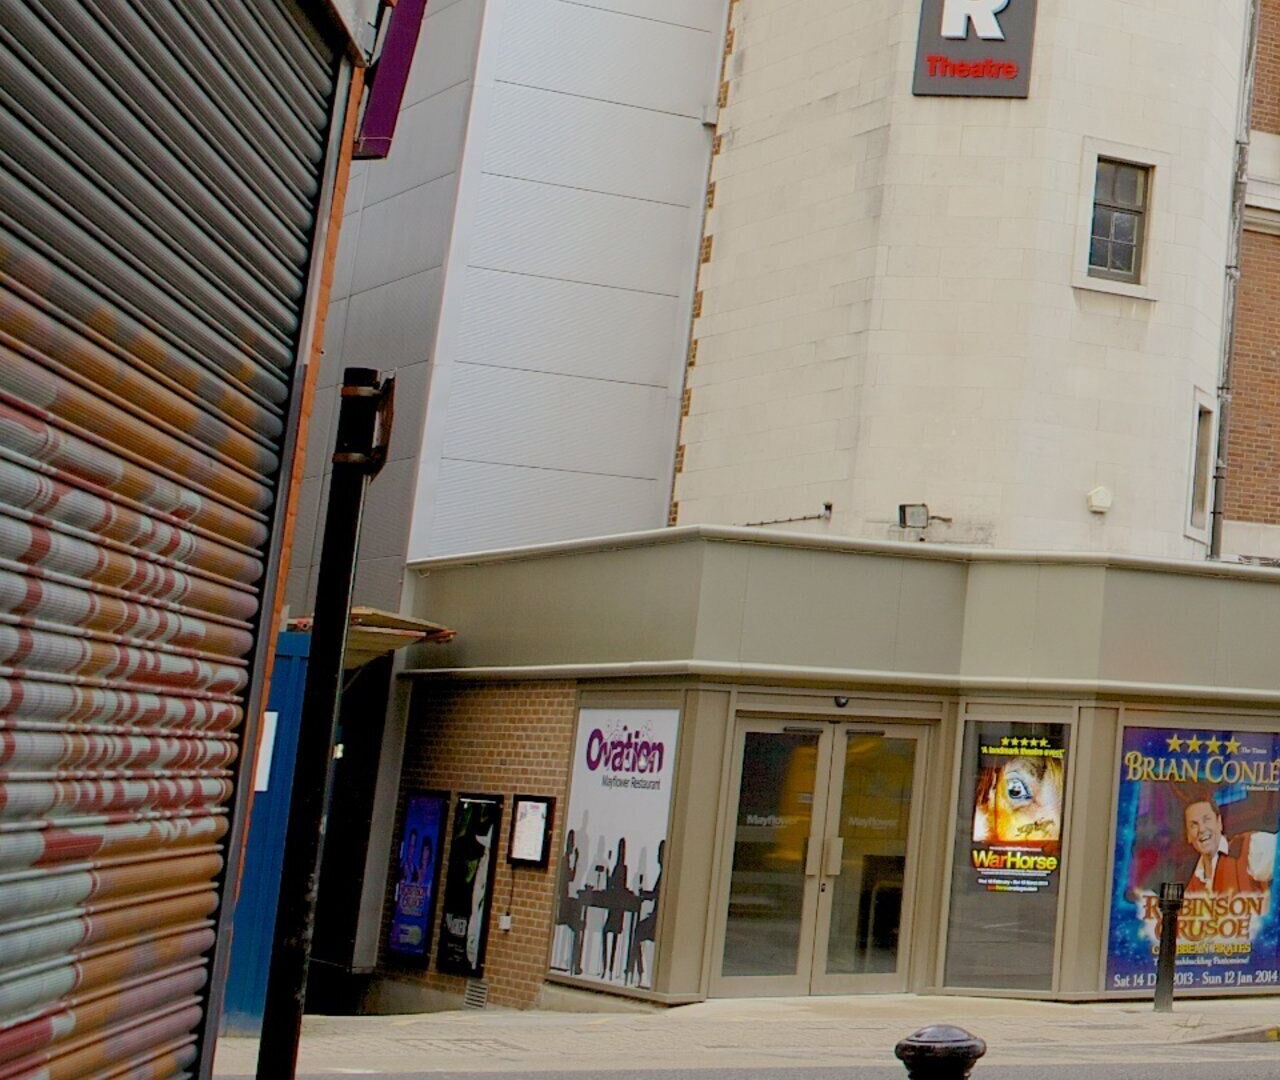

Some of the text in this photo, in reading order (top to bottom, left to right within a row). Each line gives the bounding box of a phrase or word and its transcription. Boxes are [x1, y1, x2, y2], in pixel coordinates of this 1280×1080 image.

[925, 53, 1020, 81] Theatre
[586, 725, 664, 773] Ovation
[1124, 750, 1199, 783] BRIAN
[602, 775, 661, 790] Mayflower Restaurant
[1143, 894, 1264, 920] RBINSON
[1114, 974, 1130, 987] Sat
[1133, 974, 1144, 986] 14
[1202, 972, 1222, 984] Sun
[1224, 971, 1235, 984] 12
[1237, 971, 1253, 985] Jan
[1255, 970, 1279, 983] 2014
